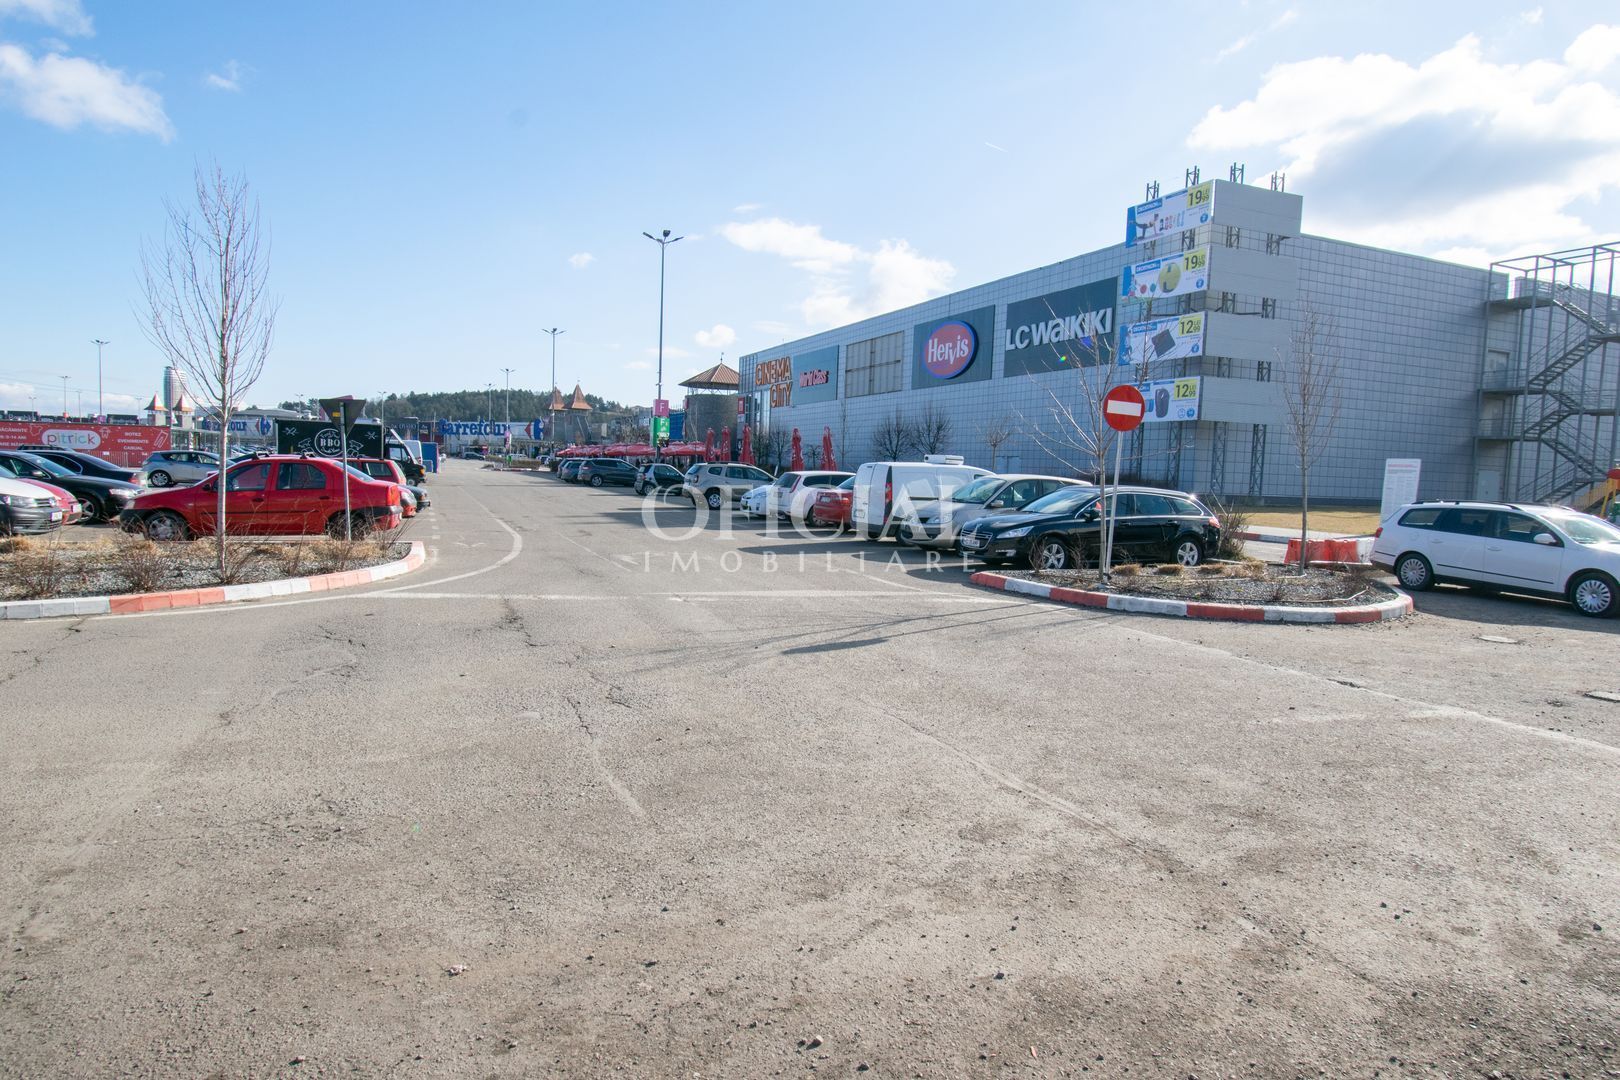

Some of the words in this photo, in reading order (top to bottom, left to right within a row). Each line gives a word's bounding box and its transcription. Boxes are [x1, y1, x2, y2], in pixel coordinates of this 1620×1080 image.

[1188, 190, 1202, 207] 19
[1184, 255, 1198, 271] 19
[1180, 320, 1194, 335] 12
[1005, 325, 1031, 351] LC
[927, 335, 969, 365] Hervis
[755, 356, 793, 386] CINEMA
[770, 381, 794, 408] CITY
[1175, 384, 1189, 398] 12
[439, 418, 511, 436] Carrefour
[47, 432, 95, 446] pitrick
